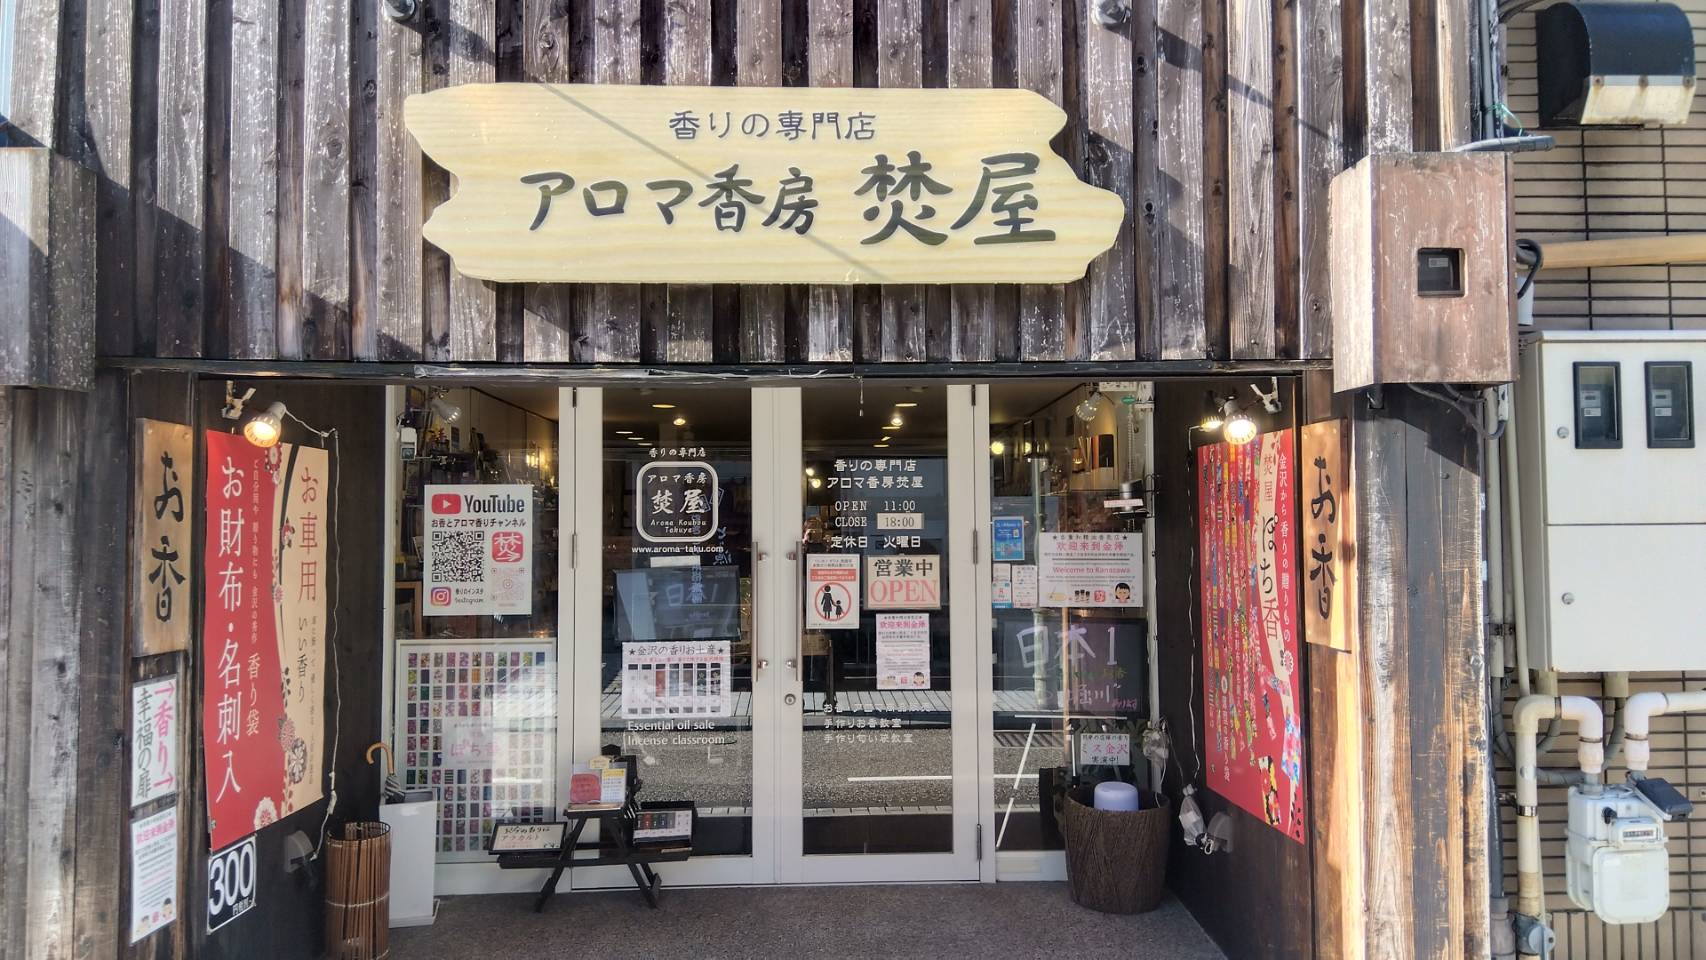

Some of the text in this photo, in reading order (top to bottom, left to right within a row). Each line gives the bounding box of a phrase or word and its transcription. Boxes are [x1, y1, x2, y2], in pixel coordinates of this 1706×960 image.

[669, 110, 877, 141] 香りの専門店
[520, 151, 1056, 245] アロマ香房 焚屋
[648, 447, 707, 458] 香りの専門店
[834, 459, 917, 472] 香りの専門店
[647, 472, 708, 484] アロマ香房
[464, 494, 525, 514] YouTube
[651, 489, 706, 514] 焚屋
[834, 501, 916, 511] OPEN 11:00
[431, 517, 527, 528] お香とアロマ香りチャンネル
[834, 517, 915, 527] CLOSE 18:00
[149, 451, 187, 622] お香
[299, 466, 318, 602] お車用
[830, 536, 921, 548] 定休日 火曜日
[1310, 455, 1337, 620] お香
[631, 545, 724, 553] www.aroma-taku.com
[1260, 454, 1280, 640] 焚屋 ぽち香
[873, 558, 933, 577] 営業中
[1053, 566, 1131, 574] Welcome to Kanazawa
[870, 580, 937, 602] OPEN
[216, 456, 245, 803] お財布・名刺入
[297, 617, 309, 704] いい香り
[245, 653, 262, 737] 香り袋
[627, 720, 715, 731] Essential oil sale
[154, 700, 174, 776] 香り
[627, 734, 725, 745] Incense classroom
[208, 843, 255, 915] 300
